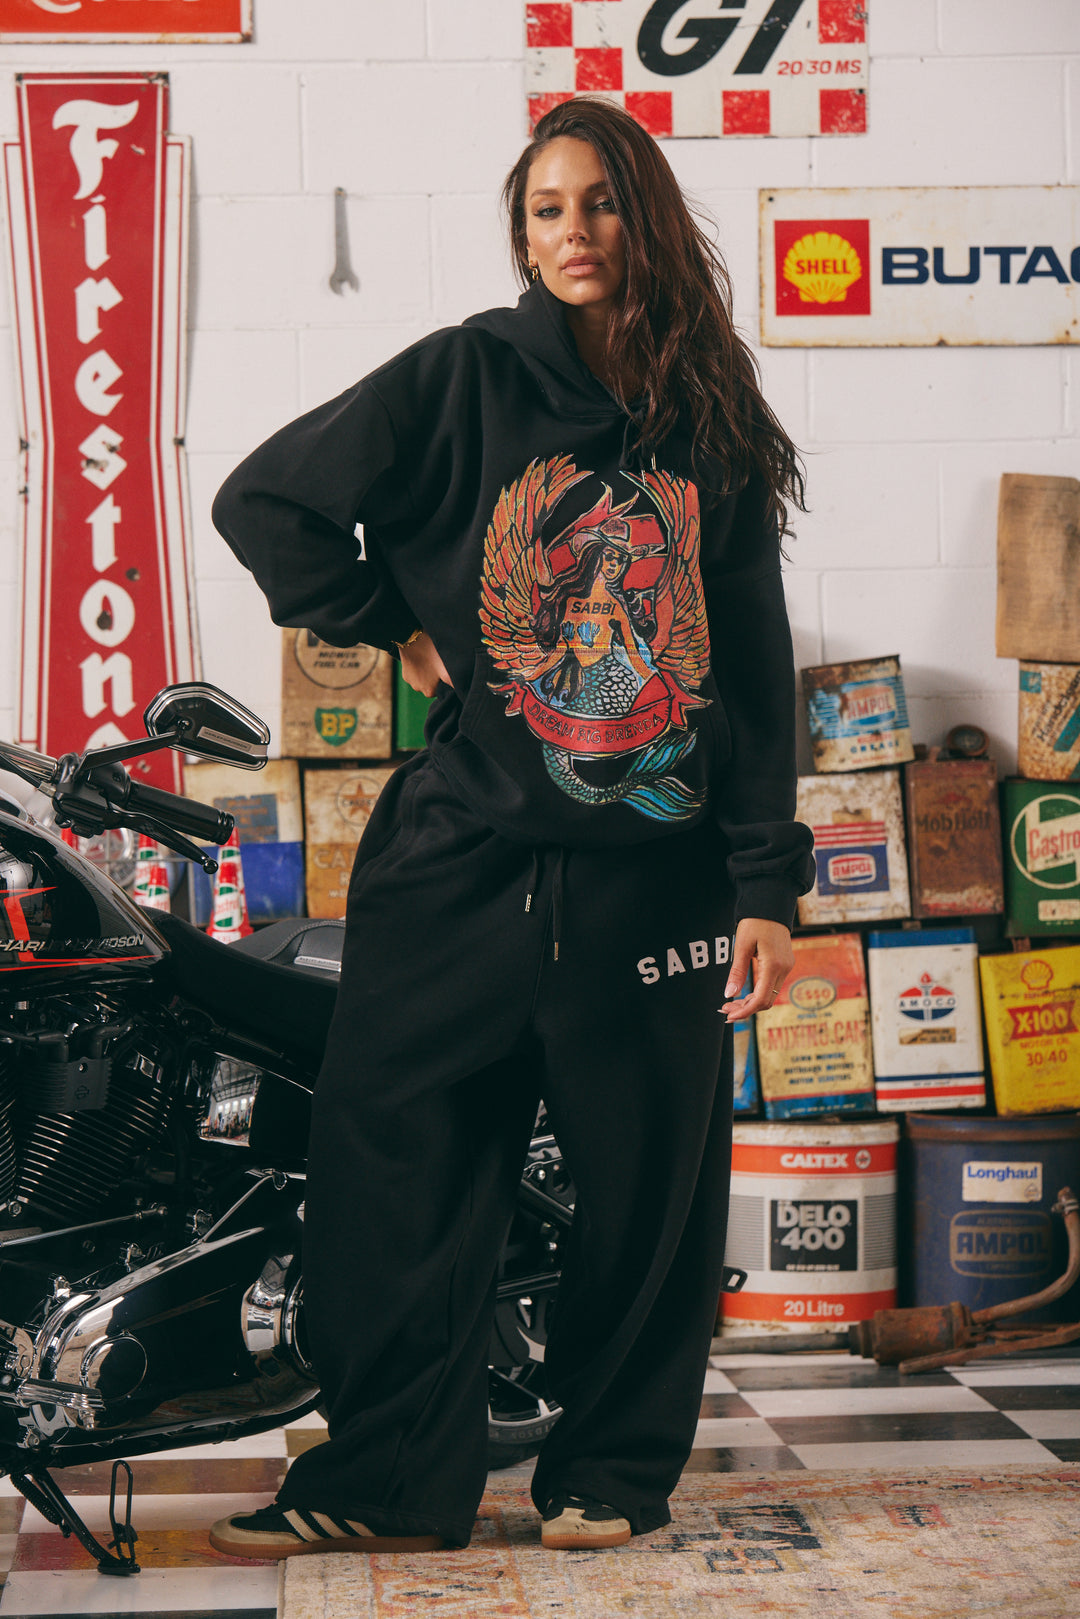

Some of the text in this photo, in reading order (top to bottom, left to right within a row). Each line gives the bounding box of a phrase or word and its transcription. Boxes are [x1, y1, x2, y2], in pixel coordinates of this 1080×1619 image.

[835, 60, 862, 75] MS
[795, 258, 851, 275] SHELL
[881, 246, 1080, 286] BUTA
[571, 601, 616, 616] SABBI
[846, 695, 892, 719] AMPOL
[321, 713, 355, 737] BP
[527, 702, 665, 744] DREAM BIG BRENDA
[832, 862, 872, 877] AMPOL
[637, 934, 737, 985] SABB
[795, 987, 832, 1001] Esso
[899, 997, 957, 1008] AMOCO
[1015, 1006, 1069, 1034] X-100
[767, 1022, 830, 1051] MIXING
[1020, 1038, 1054, 1049] MOTOR
[780, 1153, 849, 1169] CALTEX
[967, 1165, 1038, 1182] Longhaul
[776, 1204, 852, 1229] DELO
[780, 1227, 846, 1251] 400
[957, 1231, 1048, 1255] AMPOL
[783, 1300, 845, 1317] 20 Litre
